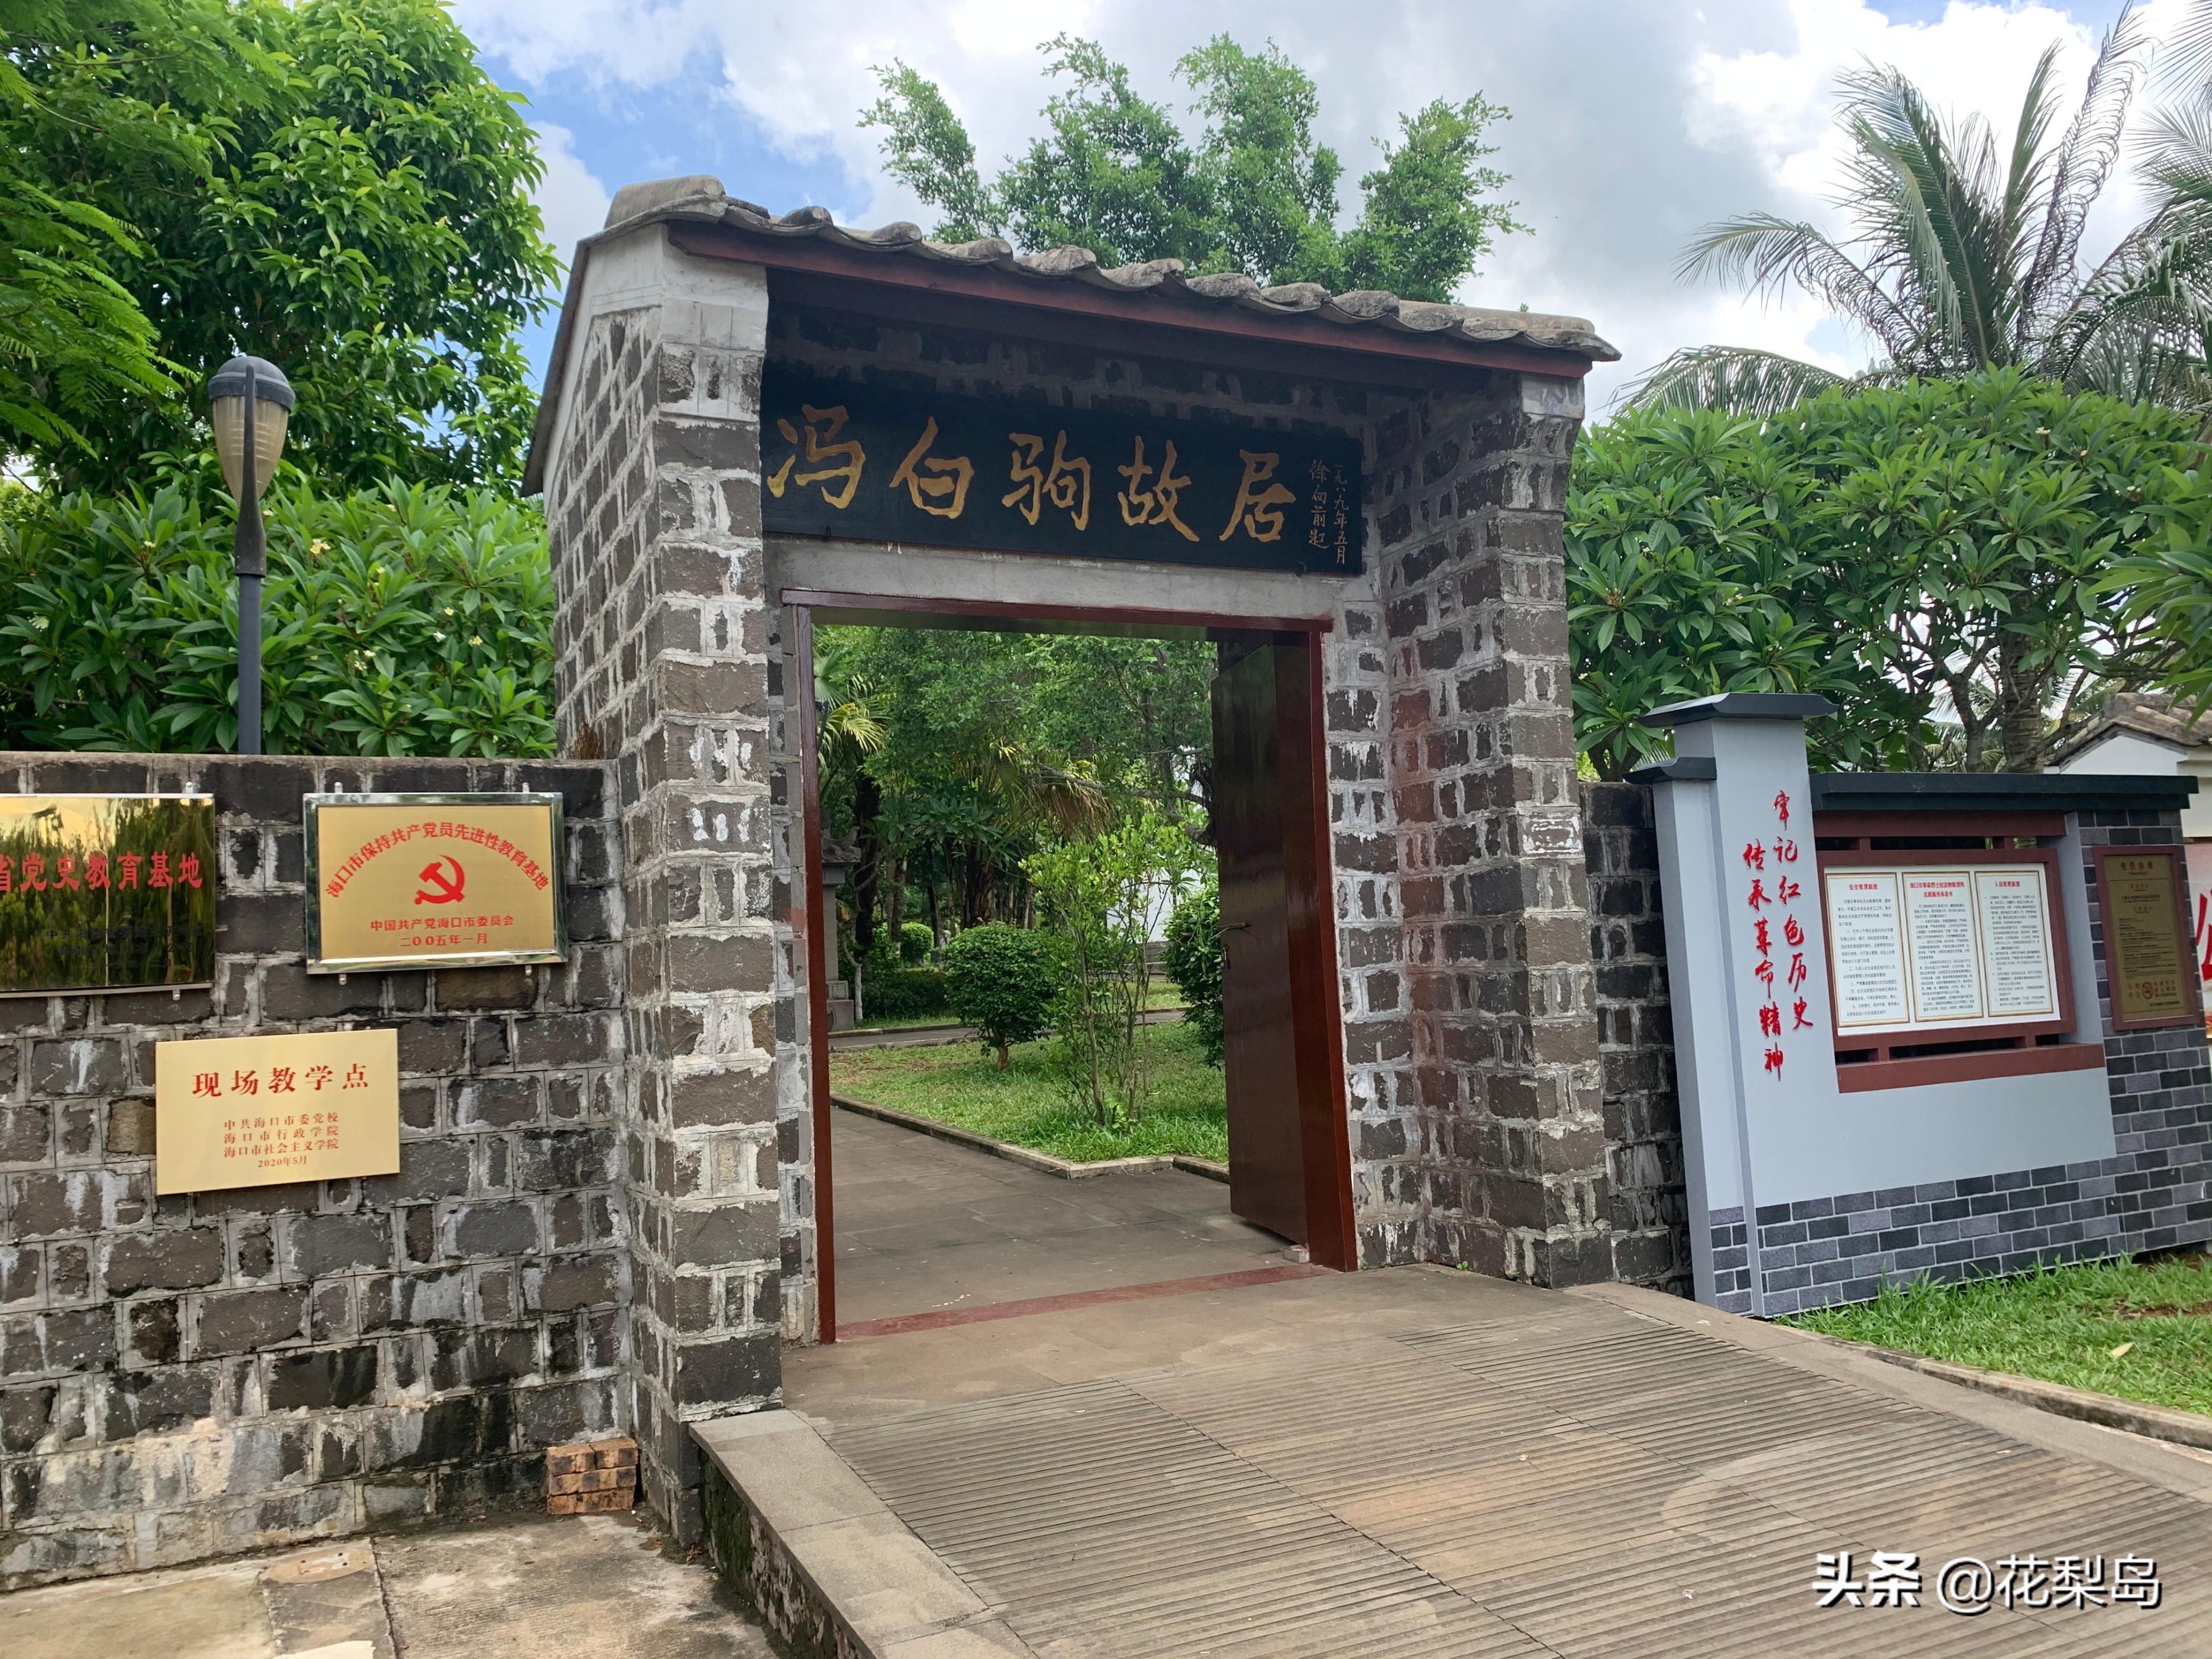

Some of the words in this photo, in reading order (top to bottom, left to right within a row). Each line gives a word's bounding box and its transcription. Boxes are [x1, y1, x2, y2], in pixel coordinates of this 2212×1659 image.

[767, 404, 1296, 542] 冯白驹故居
[1333, 464, 1349, 564] 一九八九年五月
[325, 822, 550, 898] 海口市保持共产党员先进性教育基地
[370, 915, 514, 931] 中国共产党海口市委员会
[1773, 790, 1813, 1031] 牢记红色历史
[1743, 838, 1784, 1082] 传承革命精神
[192, 1063, 369, 1098] 现场教学点
[224, 1112, 338, 1131] 中共海口市委党校
[224, 1125, 338, 1144] 海口市行政学院
[224, 1138, 338, 1158] 海口市社会主义学院
[257, 1156, 308, 1168] 2020年5月
